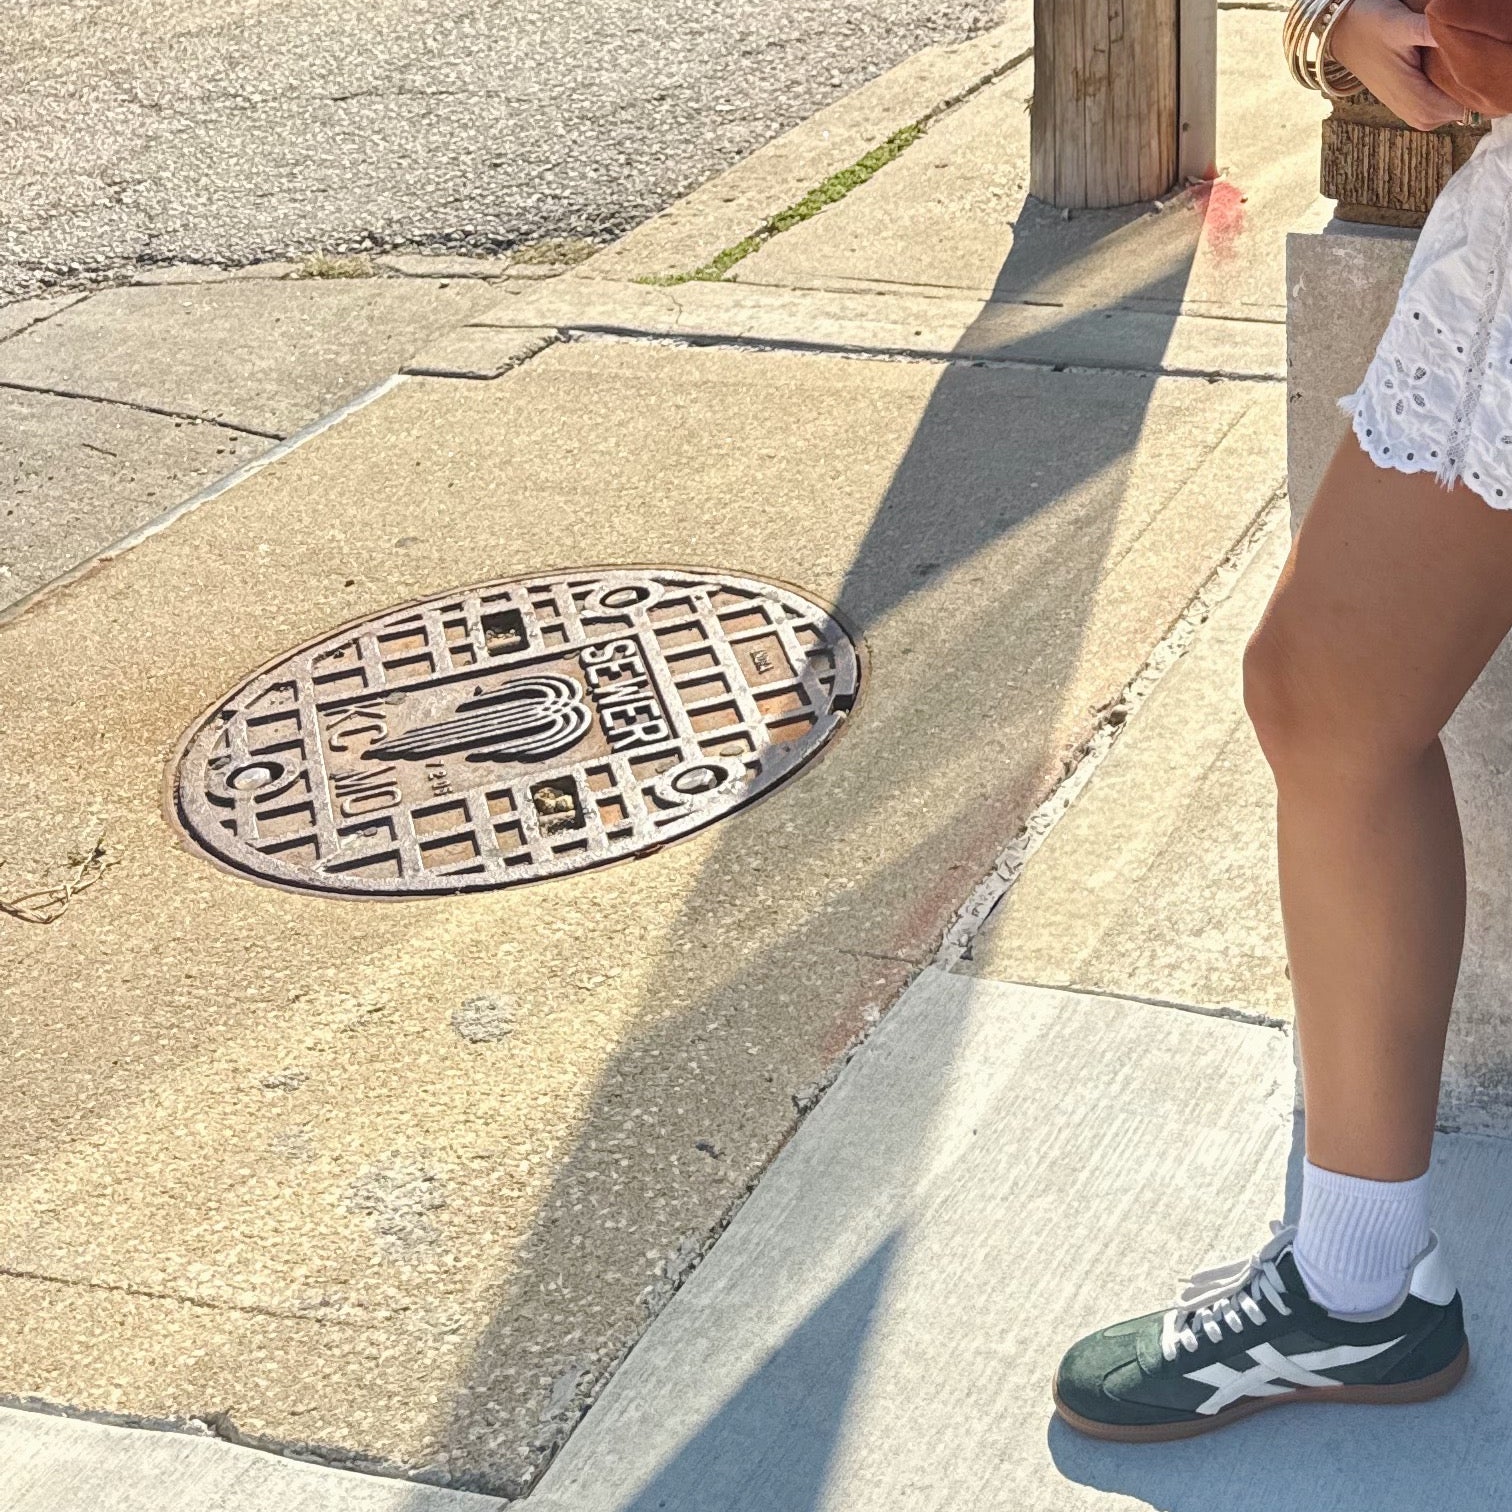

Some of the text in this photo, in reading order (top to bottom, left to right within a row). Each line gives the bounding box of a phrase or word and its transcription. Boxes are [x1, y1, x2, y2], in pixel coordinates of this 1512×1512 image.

[579, 638, 670, 753] SEWER
[323, 697, 402, 816] KC MO
